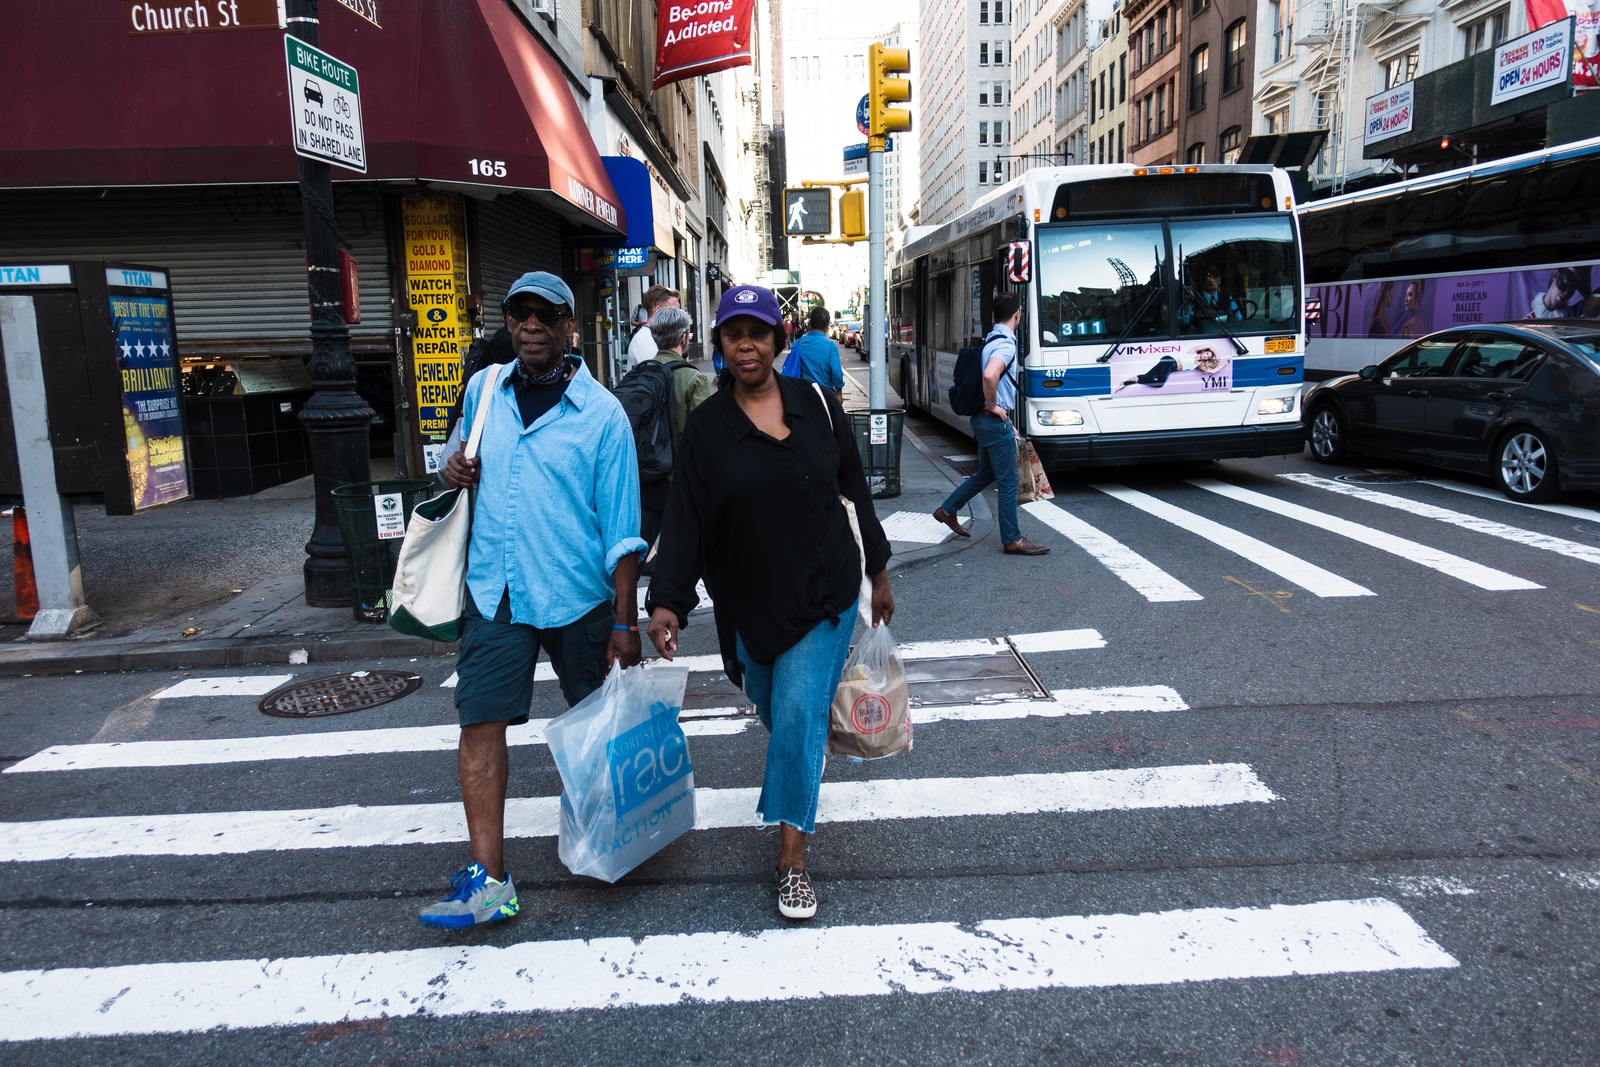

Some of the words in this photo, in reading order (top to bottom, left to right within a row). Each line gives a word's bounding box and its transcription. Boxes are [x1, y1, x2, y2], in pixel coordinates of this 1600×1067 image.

[131, 0, 209, 31] Church
[217, 0, 240, 27] St
[296, 46, 320, 72] BIKE
[321, 58, 351, 87] ROUTE
[1499, 67, 1520, 91] OPEN
[1520, 67, 1531, 85] 24
[1532, 51, 1560, 82] HOURS
[304, 109, 317, 127] DO
[318, 113, 333, 133] NOT
[335, 120, 355, 140] PASS
[1369, 116, 1383, 134] OPEN
[1382, 117, 1390, 131] 24
[1390, 106, 1409, 129] HOURS
[298, 128, 308, 146] IN
[310, 132, 341, 155] SHARED
[343, 145, 362, 163] LANE
[468, 158, 507, 178] 165
[405, 199, 425, 210] PAID
[428, 198, 446, 210] TOP
[406, 230, 424, 241] FOR
[425, 229, 451, 241] YOUR
[412, 245, 436, 256] GOLD
[439, 244, 446, 256] &
[618, 247, 642, 255] PLAY
[409, 260, 451, 271] DIAMOND
[617, 255, 645, 264] HERE.
[121, 270, 153, 287] TITAN
[410, 279, 452, 291] WATCH
[411, 293, 454, 305] BATTERY
[1451, 291, 1488, 302] AMERICAN
[1455, 302, 1481, 312] BALLET
[433, 310, 442, 320] &
[1452, 313, 1483, 323] THEATRE
[414, 327, 455, 339] WATCH
[417, 341, 458, 354] REPAIR
[416, 362, 460, 382] JEWELRY
[1045, 369, 1067, 378] 4137
[1201, 374, 1228, 389] YMI
[435, 407, 448, 418] ON
[421, 419, 449, 429] PREMI
